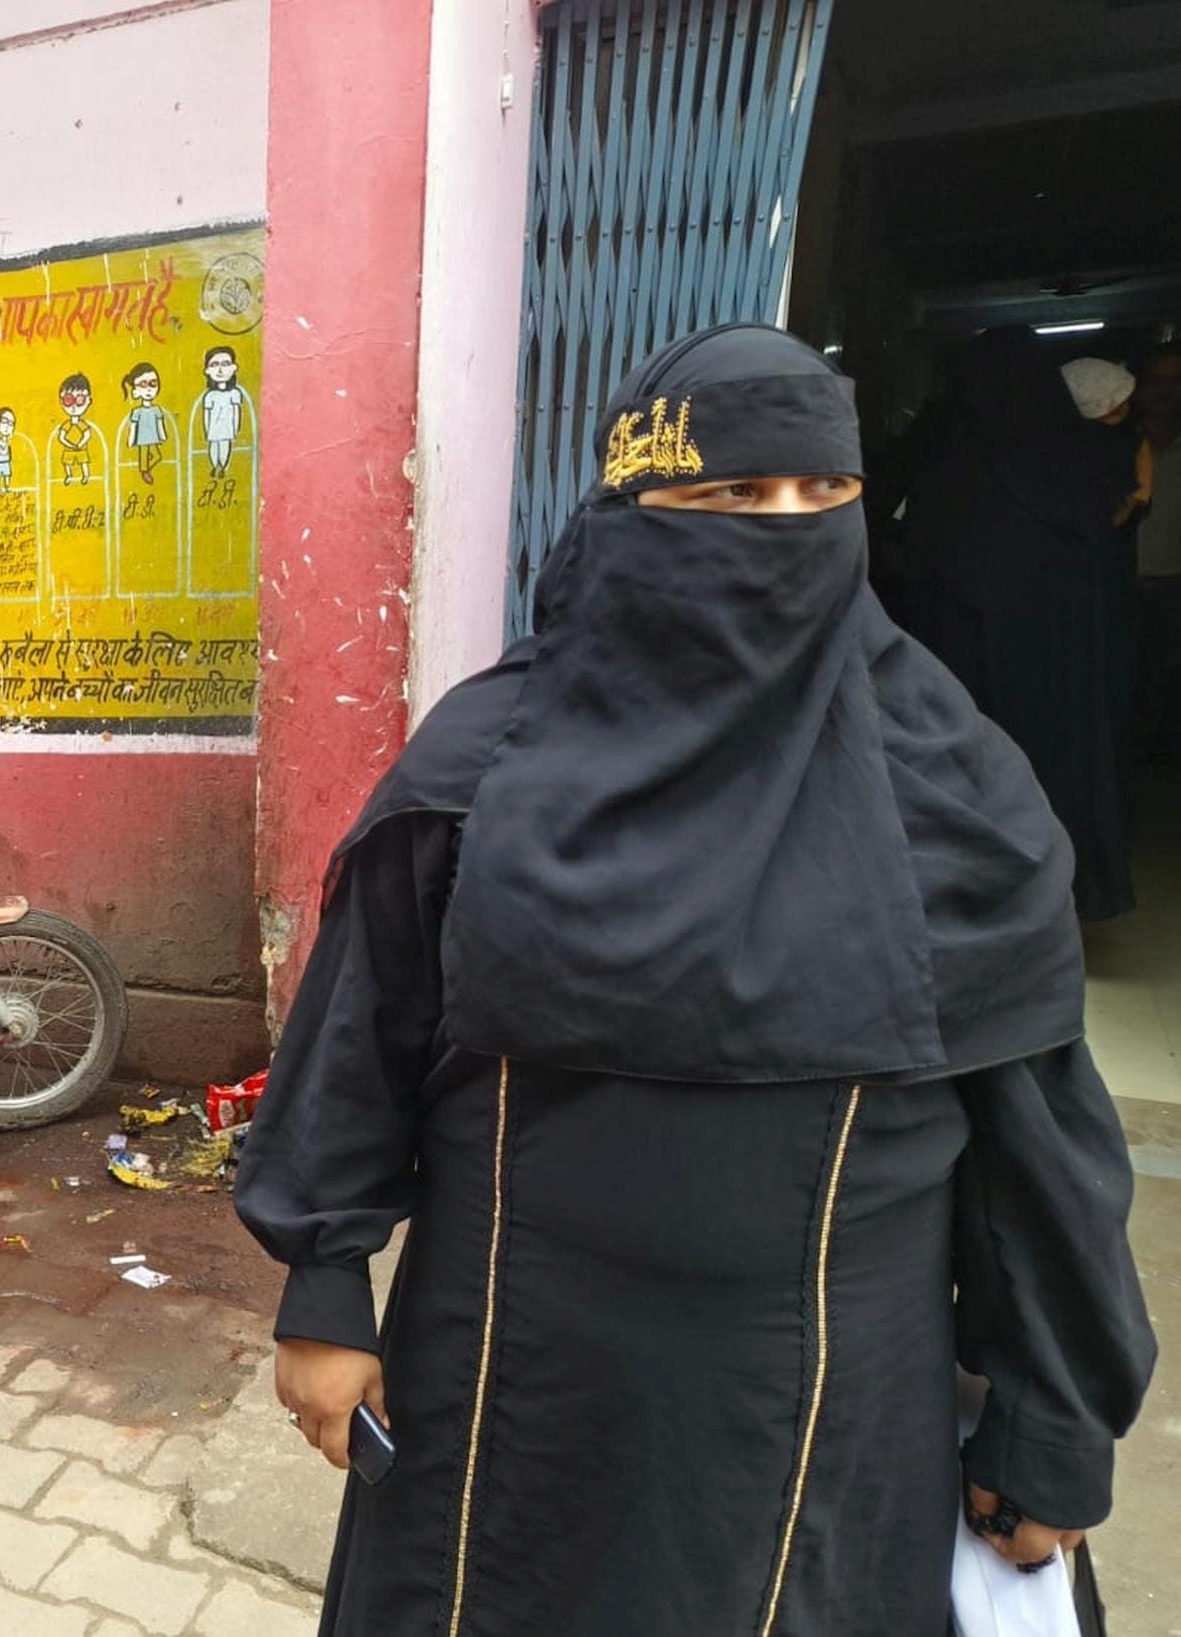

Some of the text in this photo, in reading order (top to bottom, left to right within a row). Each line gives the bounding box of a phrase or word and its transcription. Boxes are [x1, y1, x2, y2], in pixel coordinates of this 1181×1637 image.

[56, 630, 75, 669] से
[134, 669, 186, 704] जीवन
[184, 670, 243, 713] सुरक्षित
